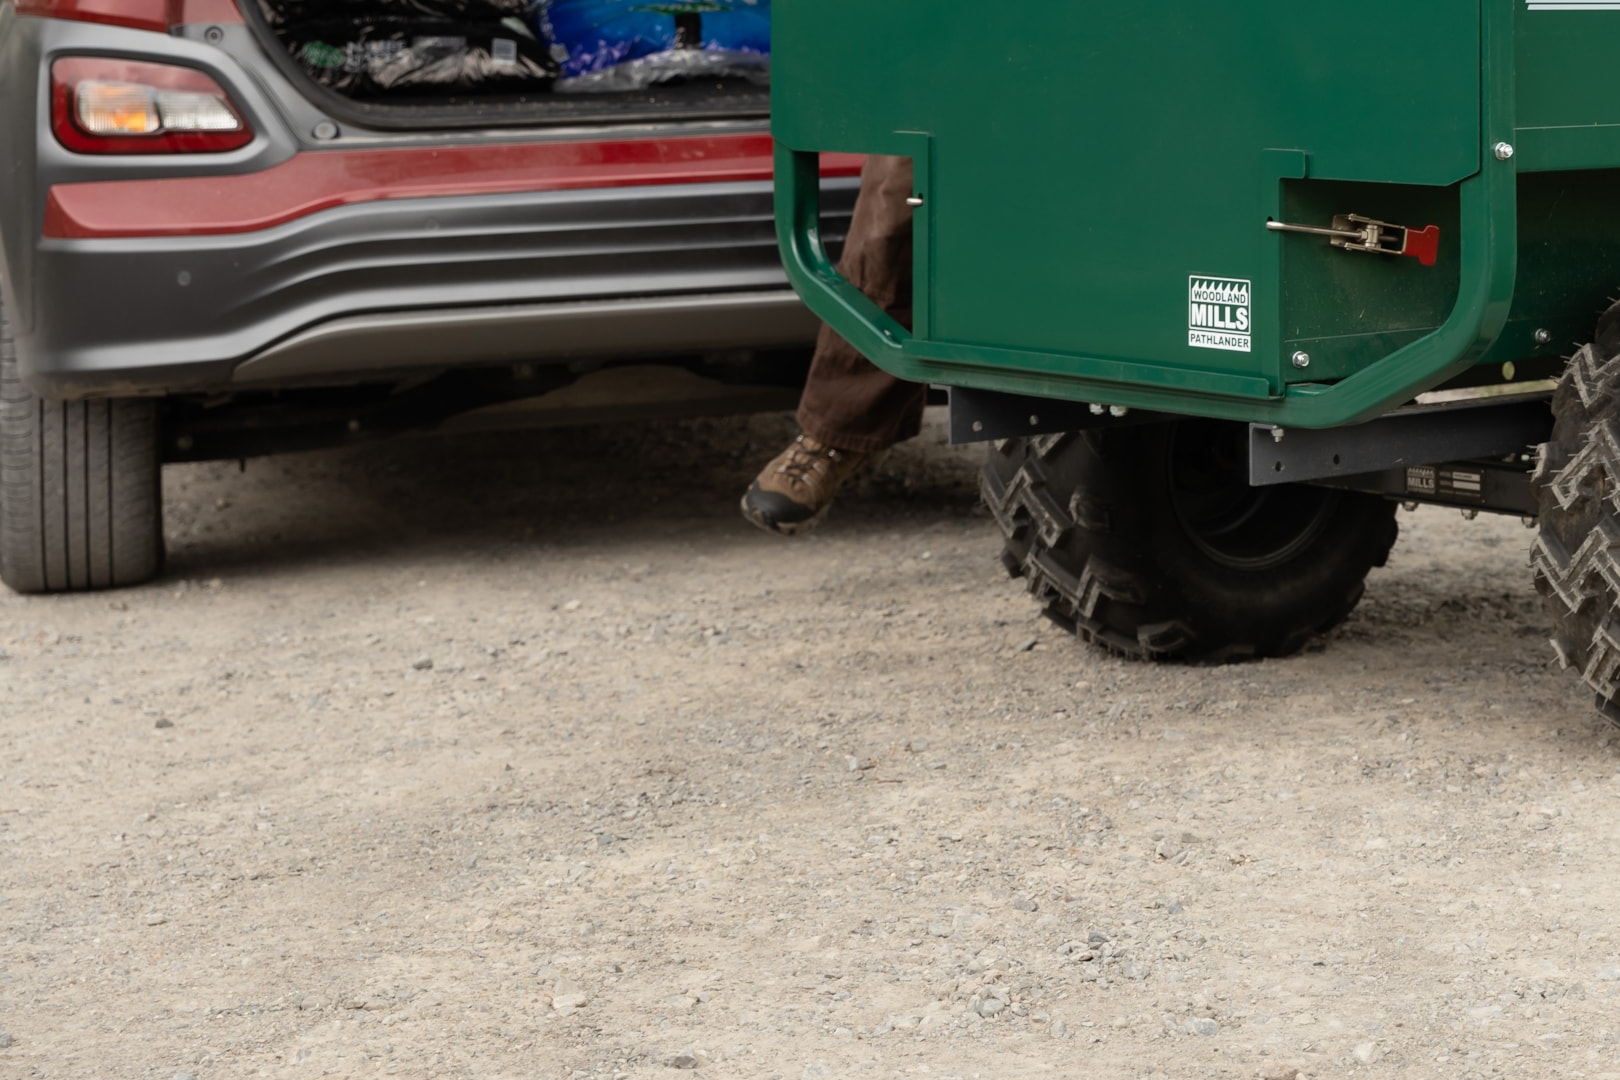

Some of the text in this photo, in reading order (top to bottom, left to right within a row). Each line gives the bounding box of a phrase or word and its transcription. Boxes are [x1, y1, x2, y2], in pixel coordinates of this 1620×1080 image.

[1193, 290, 1246, 304] WOODLAND
[1191, 303, 1248, 330] MILLS
[1190, 333, 1249, 348] PATHLANDER
[1408, 477, 1435, 489] MILLS
